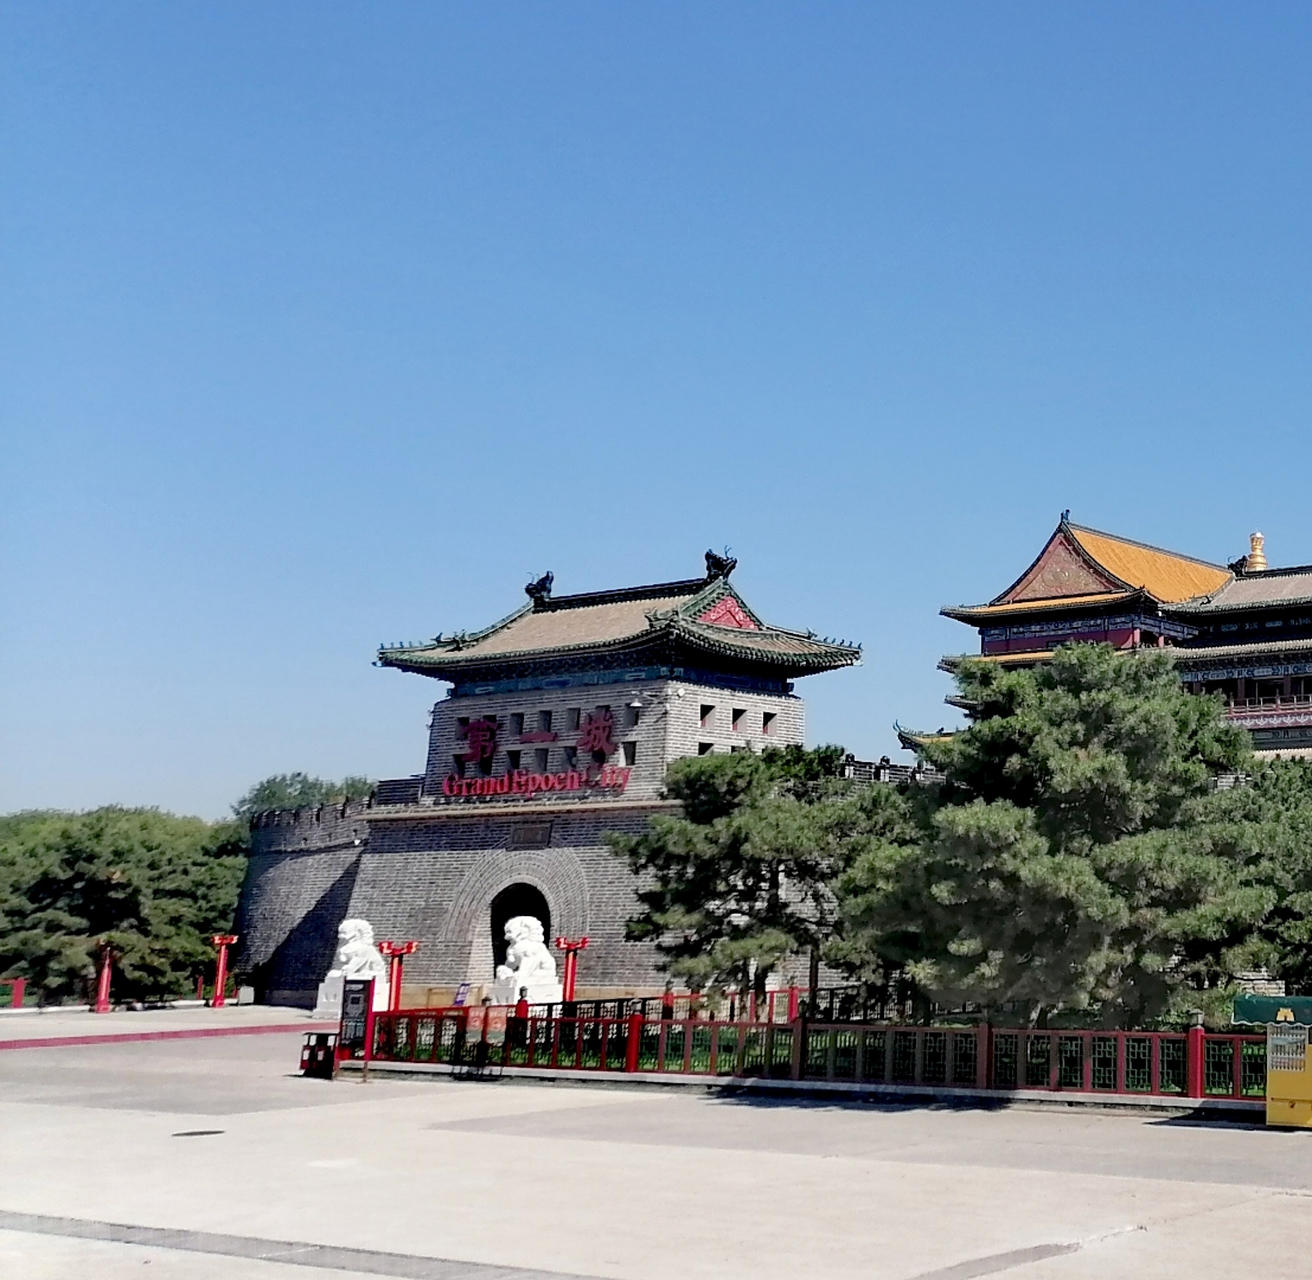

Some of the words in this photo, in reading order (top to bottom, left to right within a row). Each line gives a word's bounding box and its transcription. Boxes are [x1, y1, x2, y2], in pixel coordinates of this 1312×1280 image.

[462, 709, 619, 762] 第一城
[442, 772, 509, 797] Grand
[509, 769, 580, 799] Epoch
